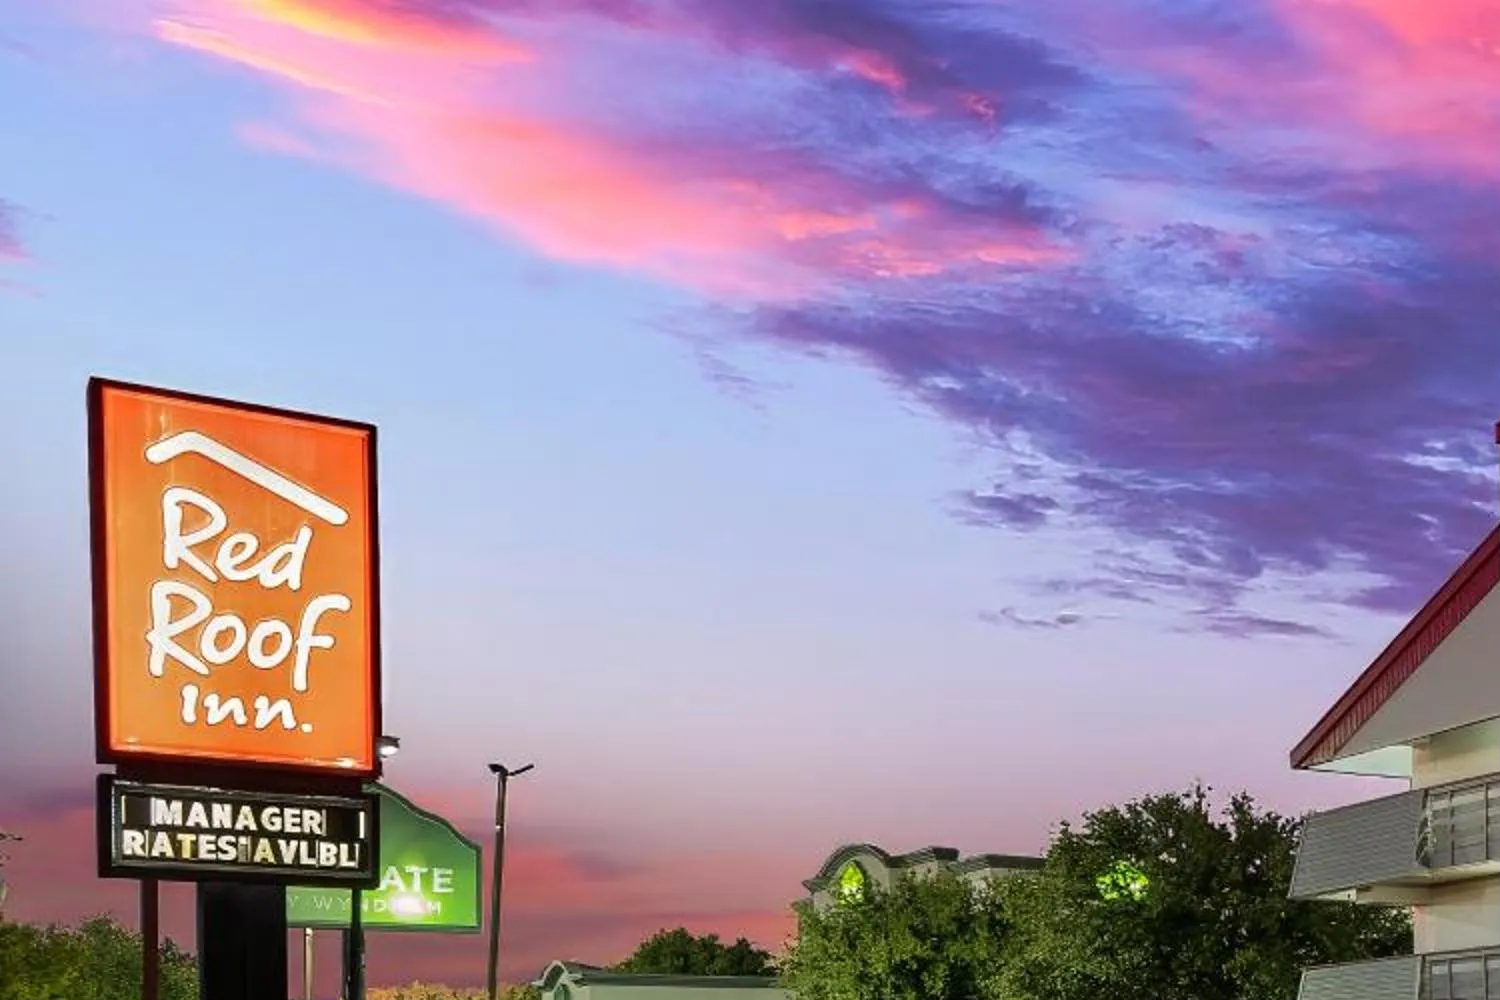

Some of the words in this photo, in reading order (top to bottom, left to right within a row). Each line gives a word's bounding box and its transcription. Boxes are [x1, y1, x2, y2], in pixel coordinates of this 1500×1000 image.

[161, 486, 313, 591] Red
[146, 580, 352, 691] Roof
[122, 829, 238, 862] RATES
[253, 837, 358, 868] AVLBL
[154, 798, 323, 836] MANAGER
